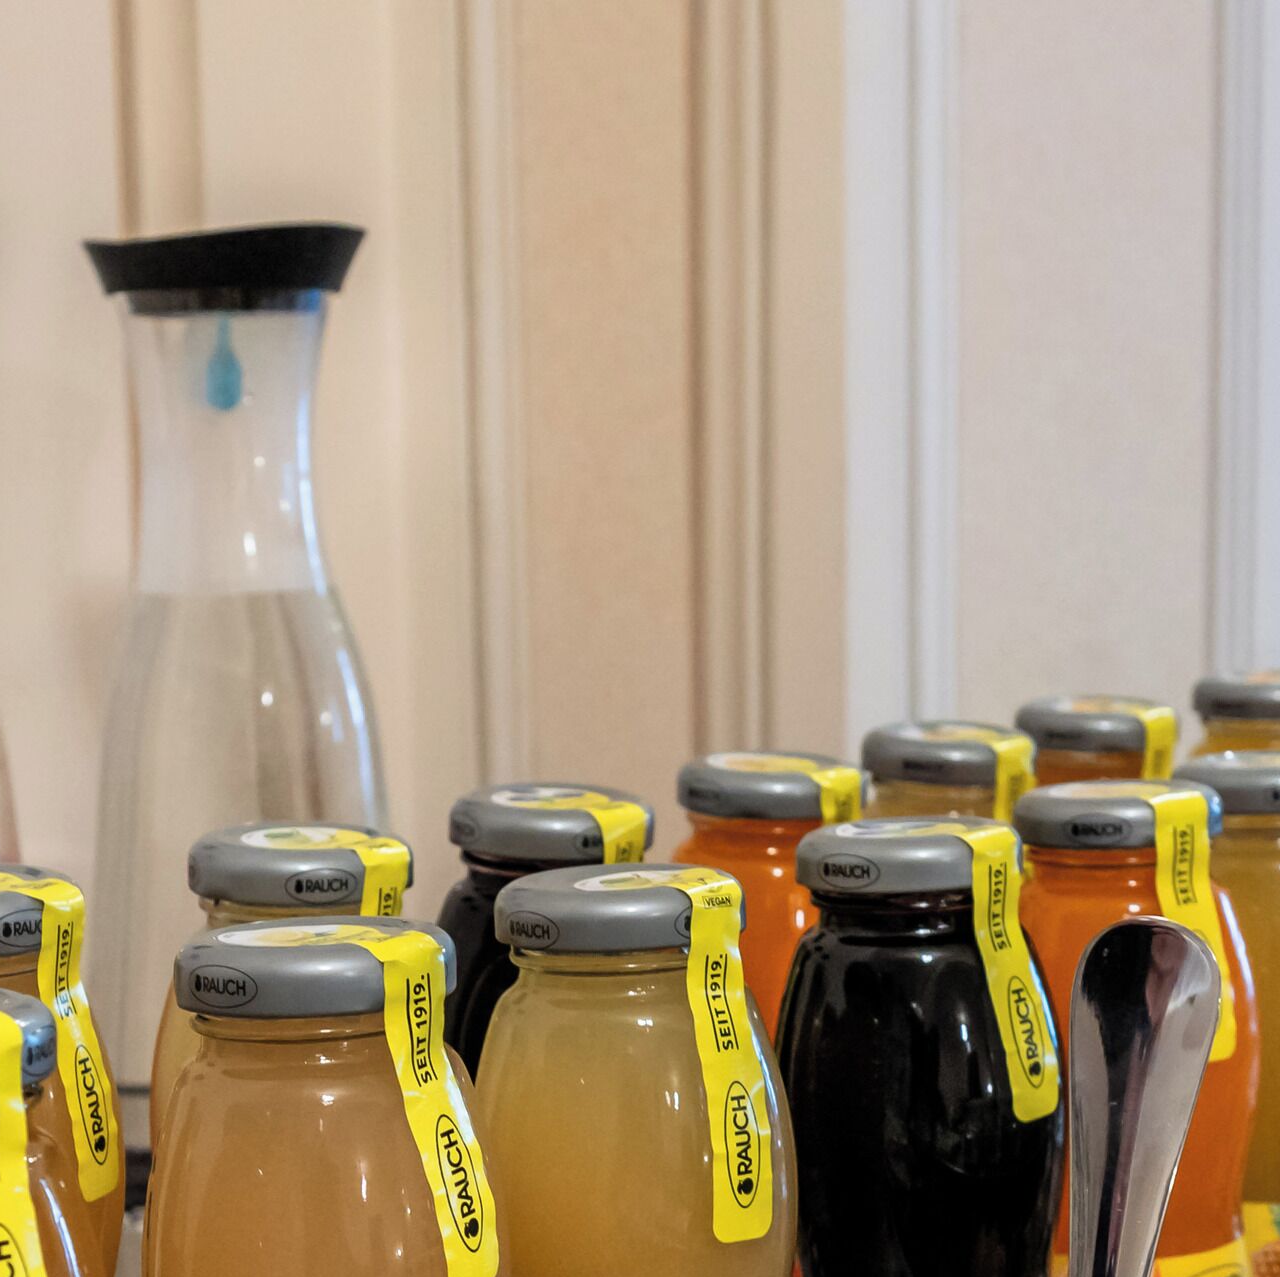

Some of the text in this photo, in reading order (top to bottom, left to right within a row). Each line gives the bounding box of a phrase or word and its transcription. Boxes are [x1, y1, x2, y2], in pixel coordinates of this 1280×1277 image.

[305, 878, 349, 893] RAUCH
[705, 896, 732, 908] VEGAN
[831, 864, 870, 879] RAUCH
[992, 863, 1008, 950] SEIT 1919.
[13, 919, 42, 936] RAUC
[517, 919, 551, 940] RAUCH
[58, 922, 73, 1017] SEIT 1919.
[203, 978, 247, 997] RAUCH
[710, 954, 734, 1051] SEIT 1919.
[413, 974, 433, 1084] SEIT 1919.
[1011, 988, 1039, 1060] RAUCH
[78, 1056, 105, 1134] RAUCH
[730, 1094, 753, 1176] RAUCH
[440, 1128, 476, 1219] RAUCH
